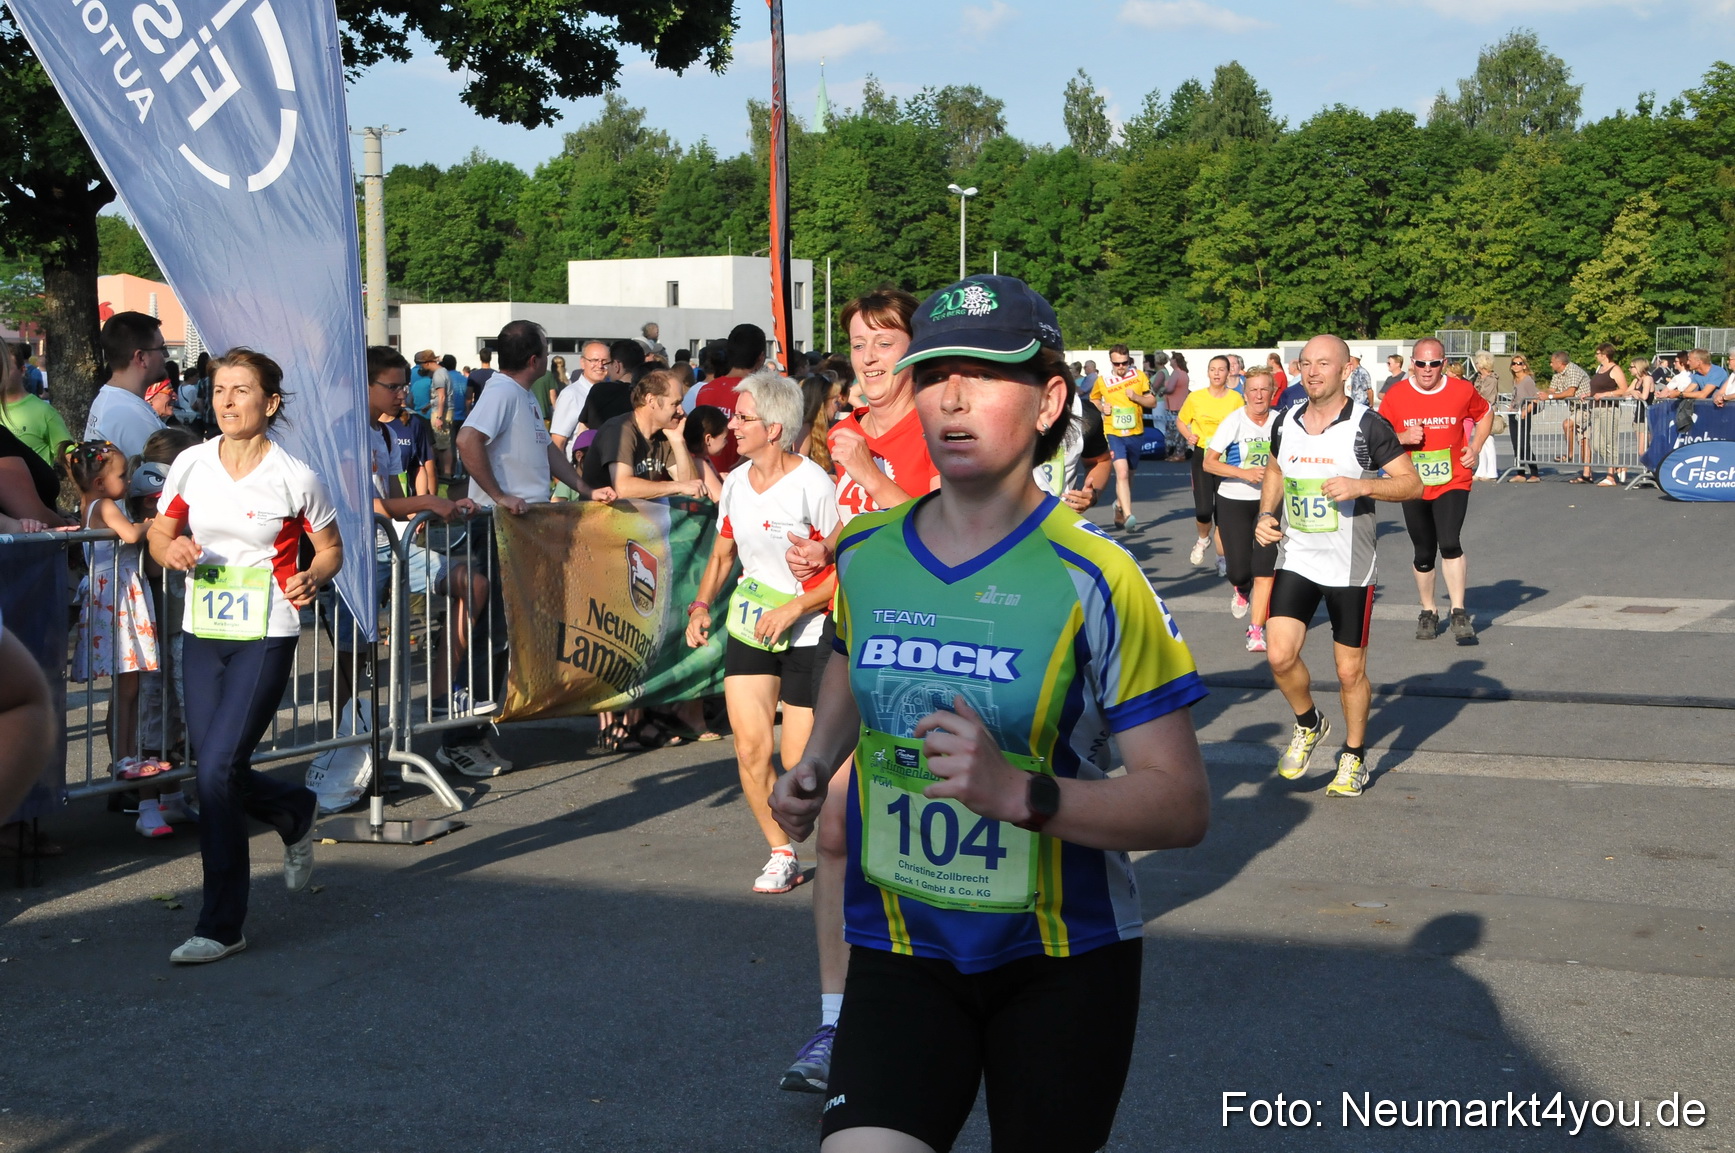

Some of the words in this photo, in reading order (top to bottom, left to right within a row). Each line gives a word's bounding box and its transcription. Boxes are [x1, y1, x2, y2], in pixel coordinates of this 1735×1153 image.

[1115, 414, 1132, 424] 789
[1413, 461, 1450, 477] 1343
[1291, 495, 1327, 518] 515
[202, 590, 249, 621] 121
[872, 608, 937, 628] TEAM
[858, 637, 1020, 682] BOCK
[887, 793, 1007, 871] 104
[898, 859, 936, 878] Christine
[936, 871, 989, 884] Zollbrecht
[894, 872, 913, 886] Bock
[921, 878, 946, 894] GmbH
[949, 886, 956, 895] &
[958, 887, 974, 897] Co.
[976, 889, 991, 898] KG
